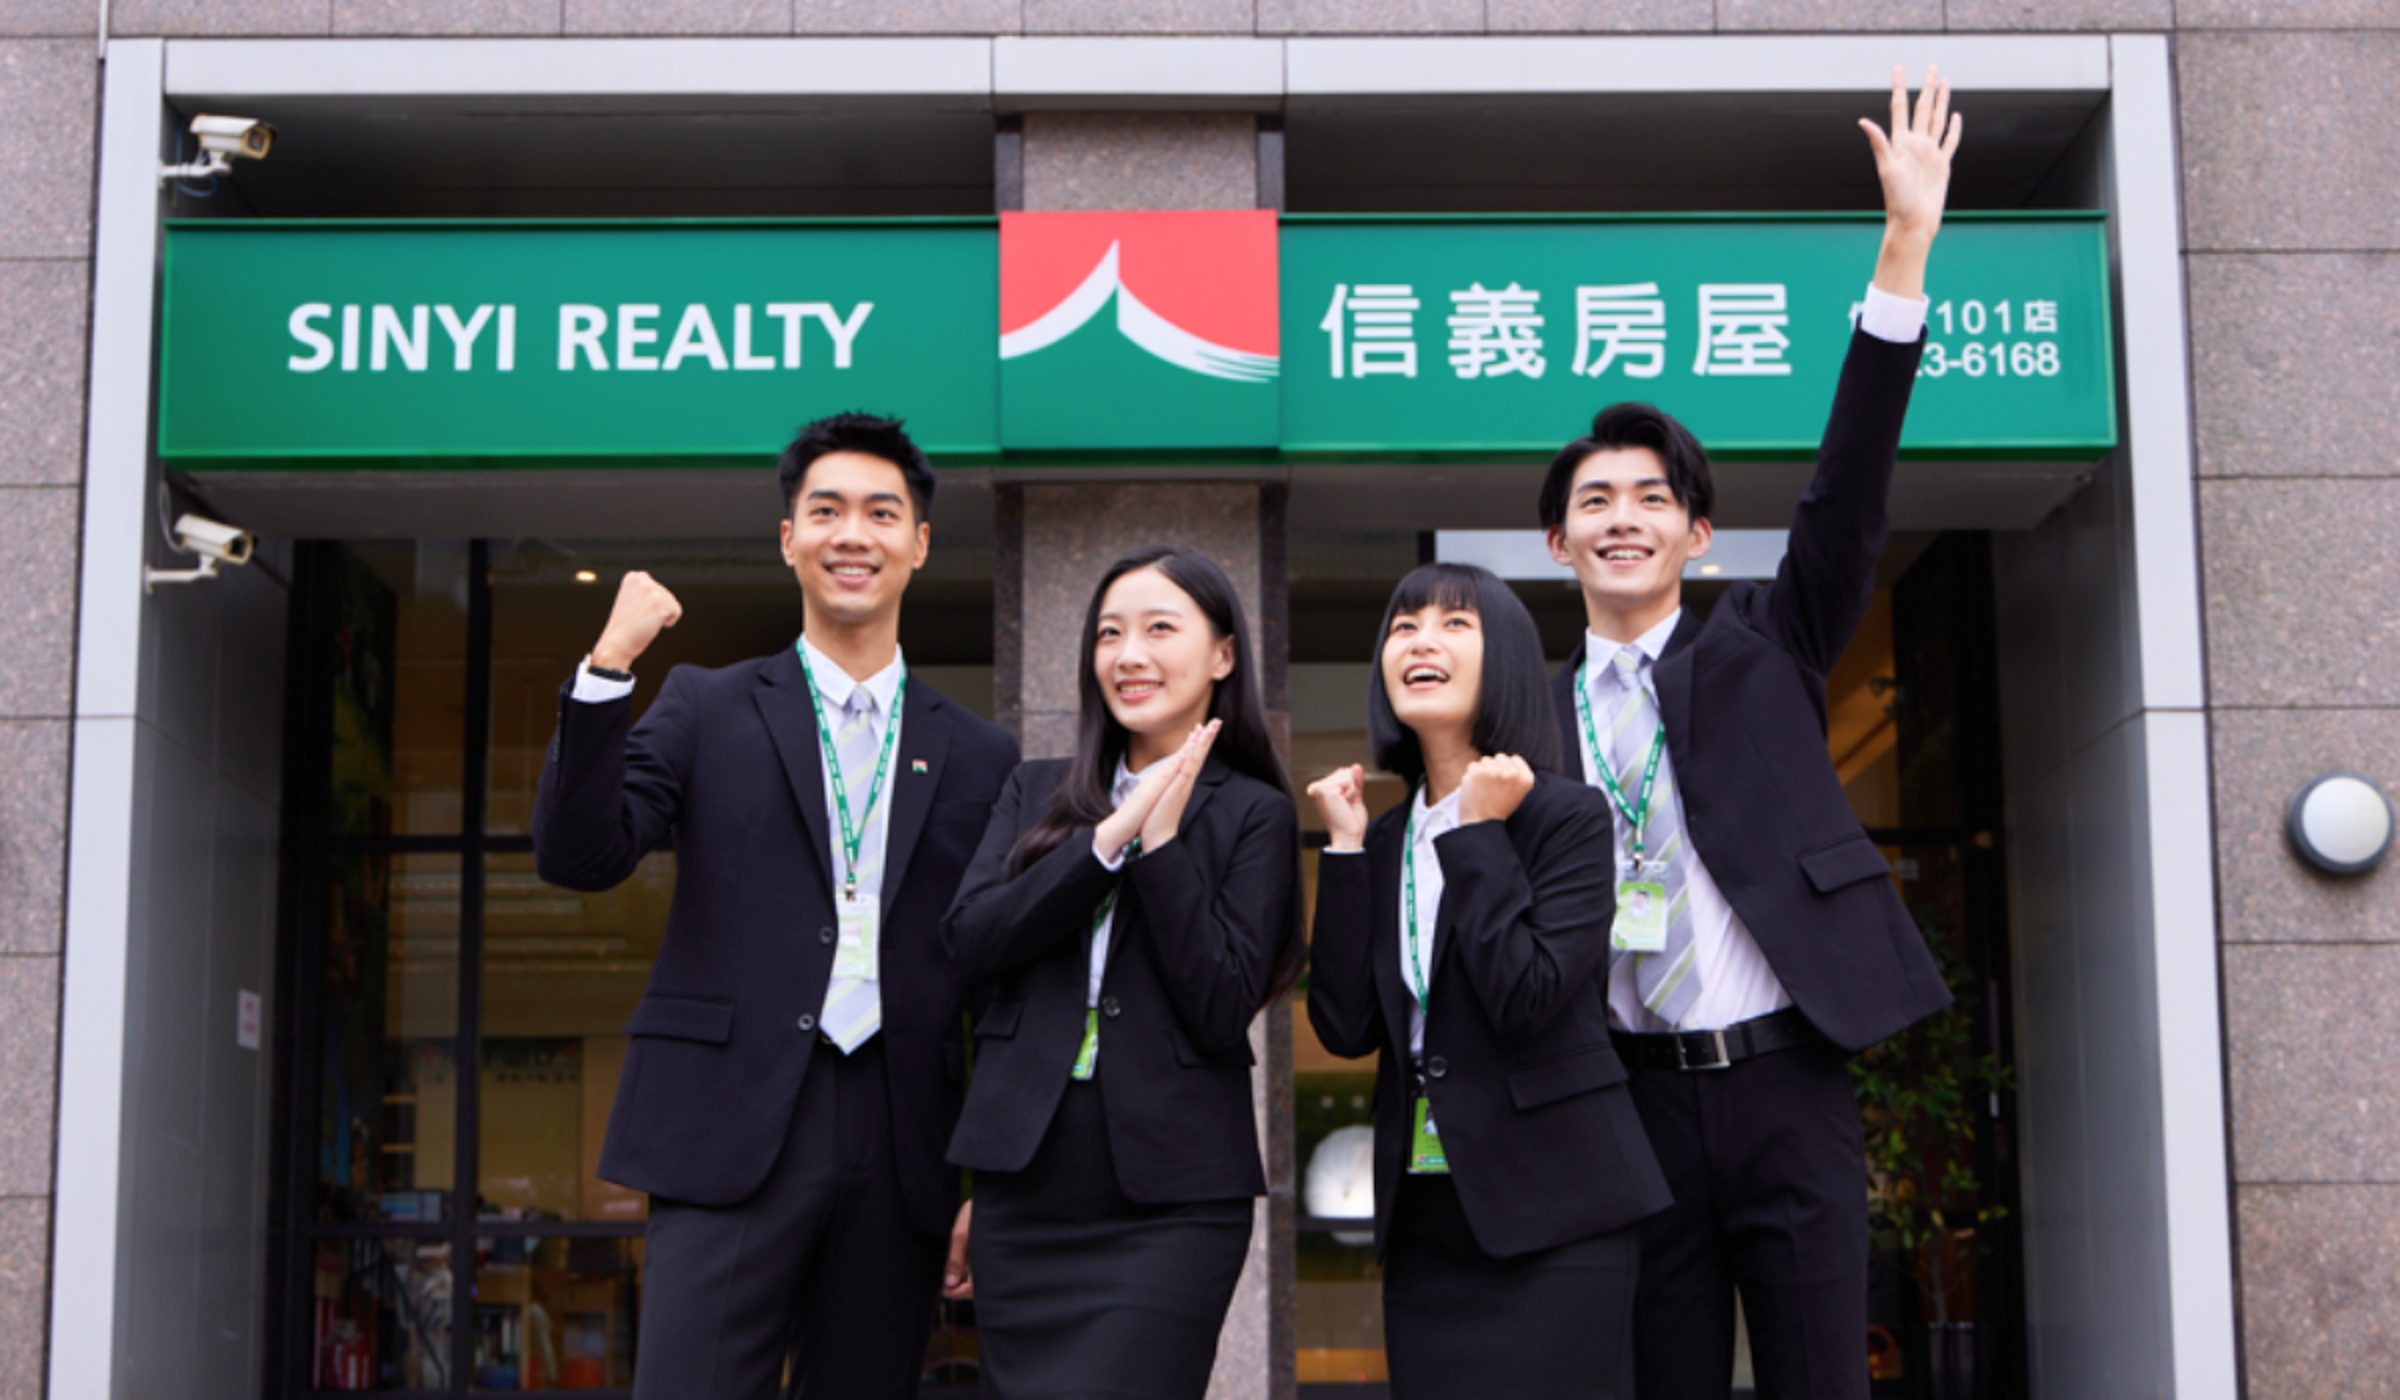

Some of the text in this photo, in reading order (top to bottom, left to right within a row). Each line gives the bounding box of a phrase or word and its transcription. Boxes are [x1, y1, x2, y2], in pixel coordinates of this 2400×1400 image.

[288, 302, 874, 372] SINYI REALTY
[1320, 281, 1792, 379] 信義房屋
[1915, 341, 2061, 377] 3-6168
